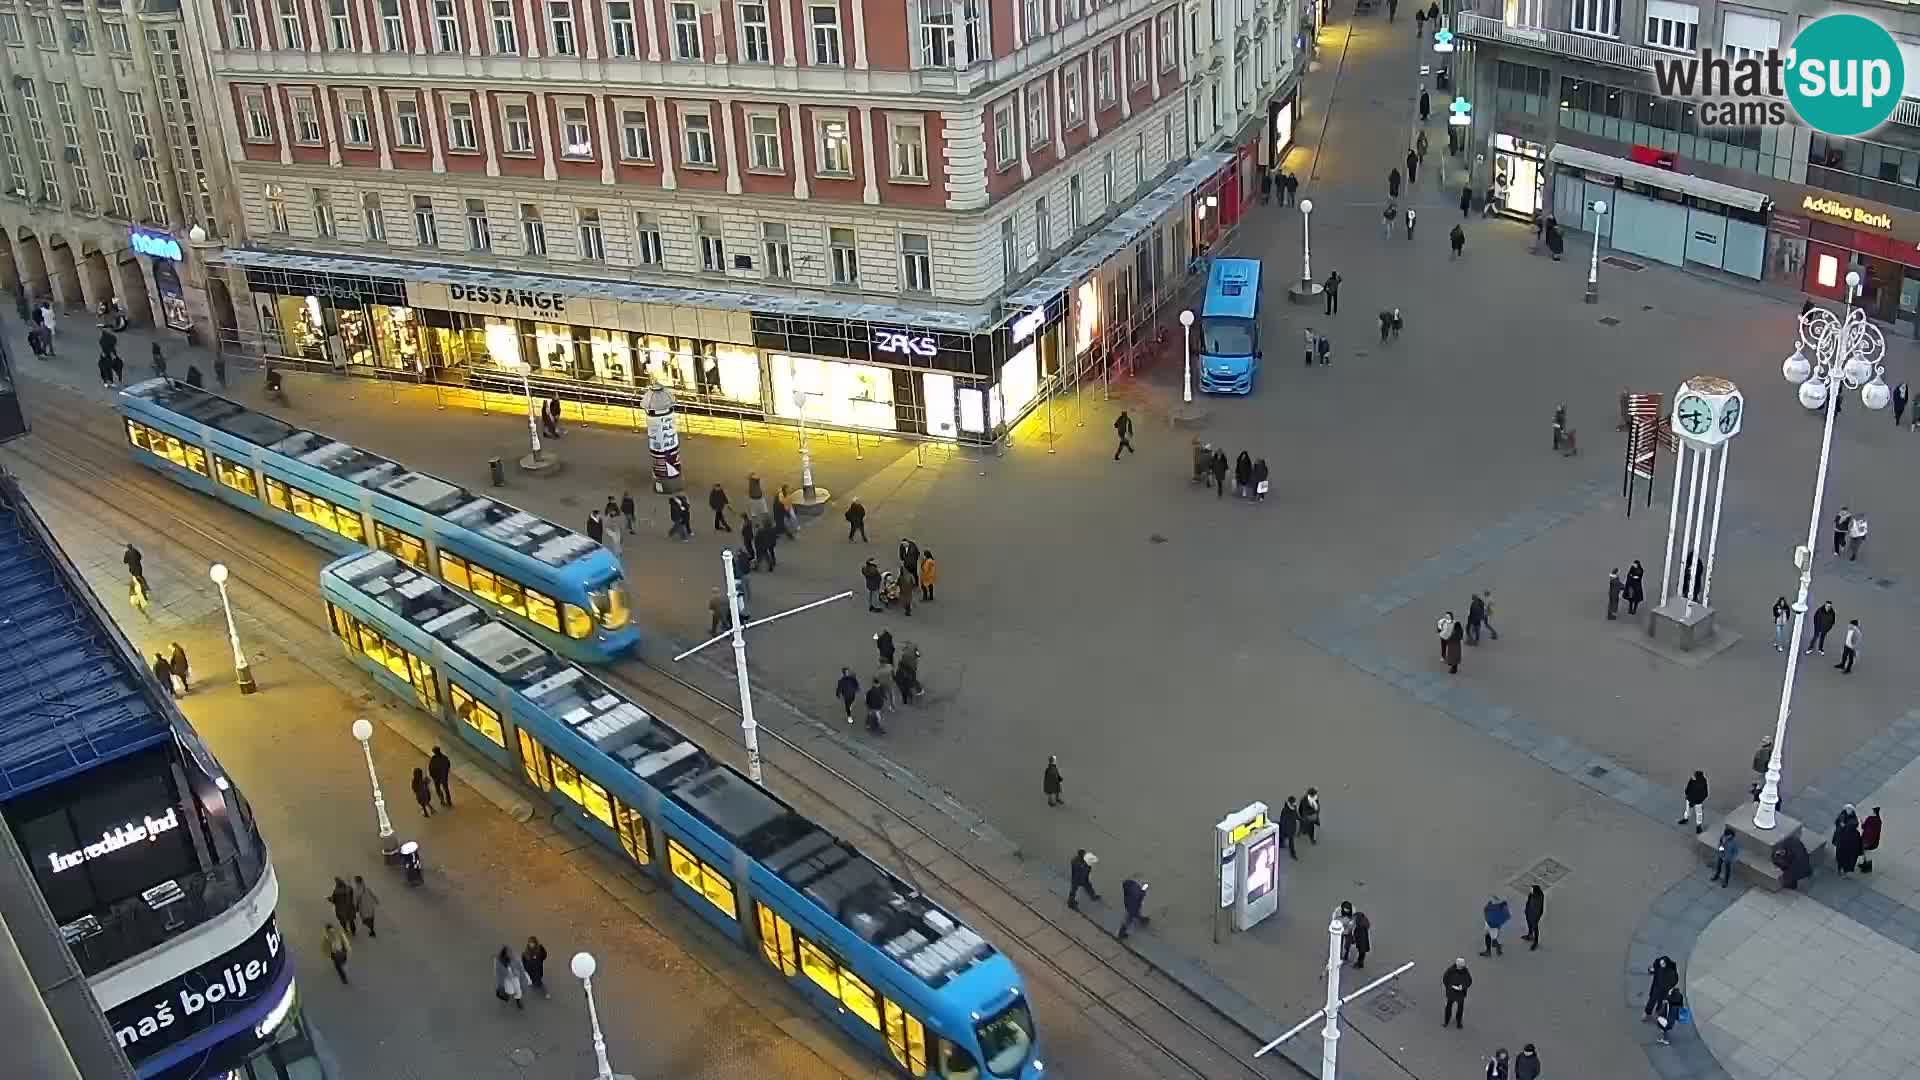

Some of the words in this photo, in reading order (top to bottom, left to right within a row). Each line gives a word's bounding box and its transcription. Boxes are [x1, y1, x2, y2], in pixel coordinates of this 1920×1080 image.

[1803, 195, 1852, 220] Addiko
[1853, 207, 1891, 229] Bank
[450, 283, 565, 311] DESSANGE
[875, 331, 937, 356] ZAKS
[115, 999, 176, 1049] naš
[179, 958, 268, 1016] bolje,
